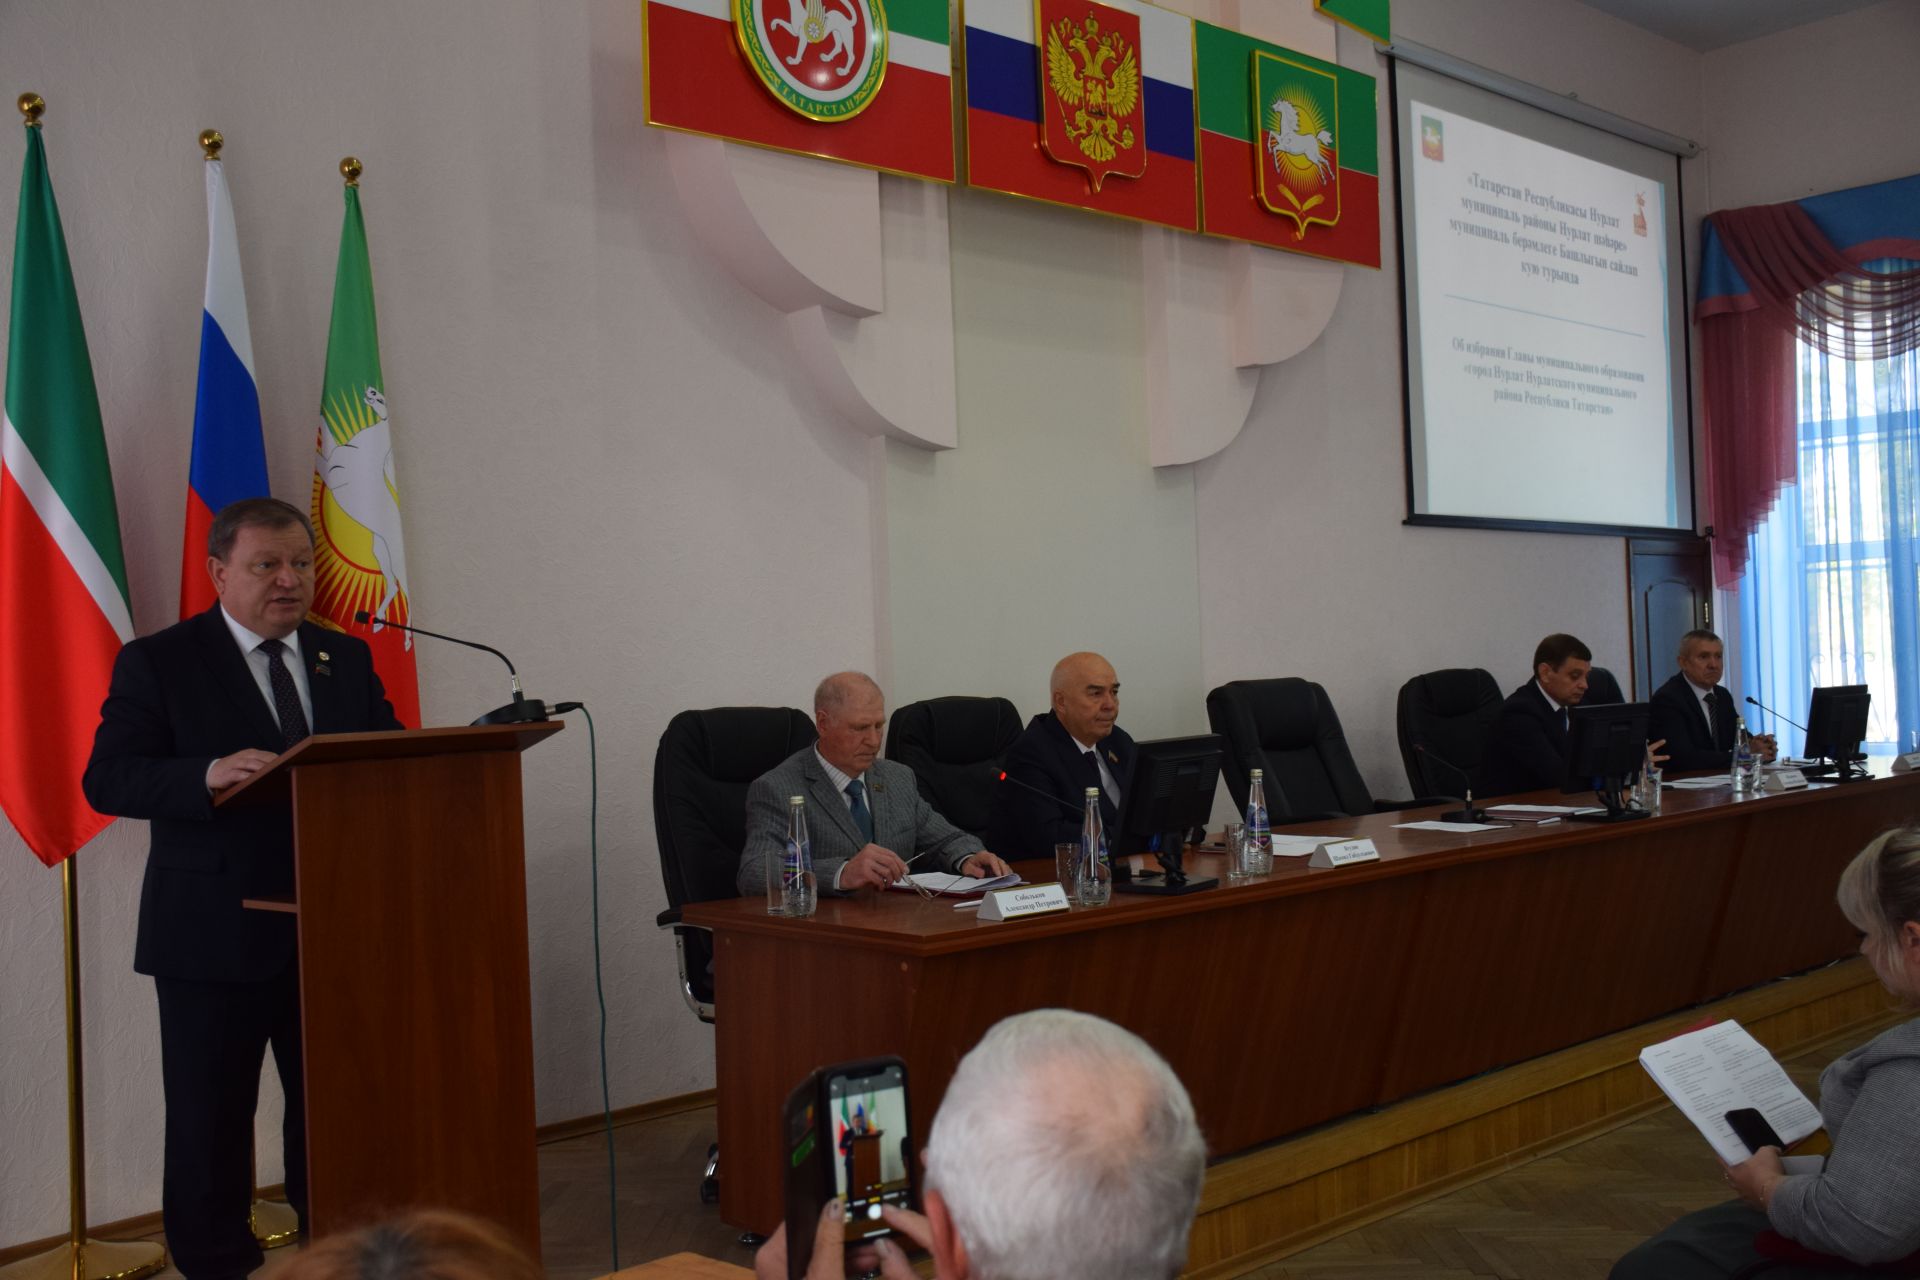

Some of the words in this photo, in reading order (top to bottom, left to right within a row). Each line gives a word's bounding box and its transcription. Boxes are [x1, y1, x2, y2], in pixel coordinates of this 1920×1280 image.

[782, 86, 855, 115] ТАТАРСТАН
[1461, 197, 1520, 223] муниципаль
[1522, 213, 1557, 233] районы
[1560, 220, 1591, 243] Нурлат
[1525, 187, 1587, 219] Республикасы
[1590, 207, 1619, 228] Нурлат
[1450, 219, 1510, 244] муниципаль
[1512, 231, 1558, 256] берәмлеге
[1560, 243, 1607, 269] Башлыгын
[1610, 259, 1638, 277] сайлап
[1542, 266, 1579, 284] турында
[1452, 336, 1464, 352] Об
[1507, 346, 1534, 363] Главы
[1536, 355, 1599, 376] муниципального
[1601, 363, 1644, 383] образования
[1494, 365, 1524, 384] Нурлат
[1526, 370, 1575, 391] Нурлатского
[1577, 382, 1637, 400] муниципального
[1494, 388, 1522, 403] района
[1524, 390, 1569, 409] Республики
